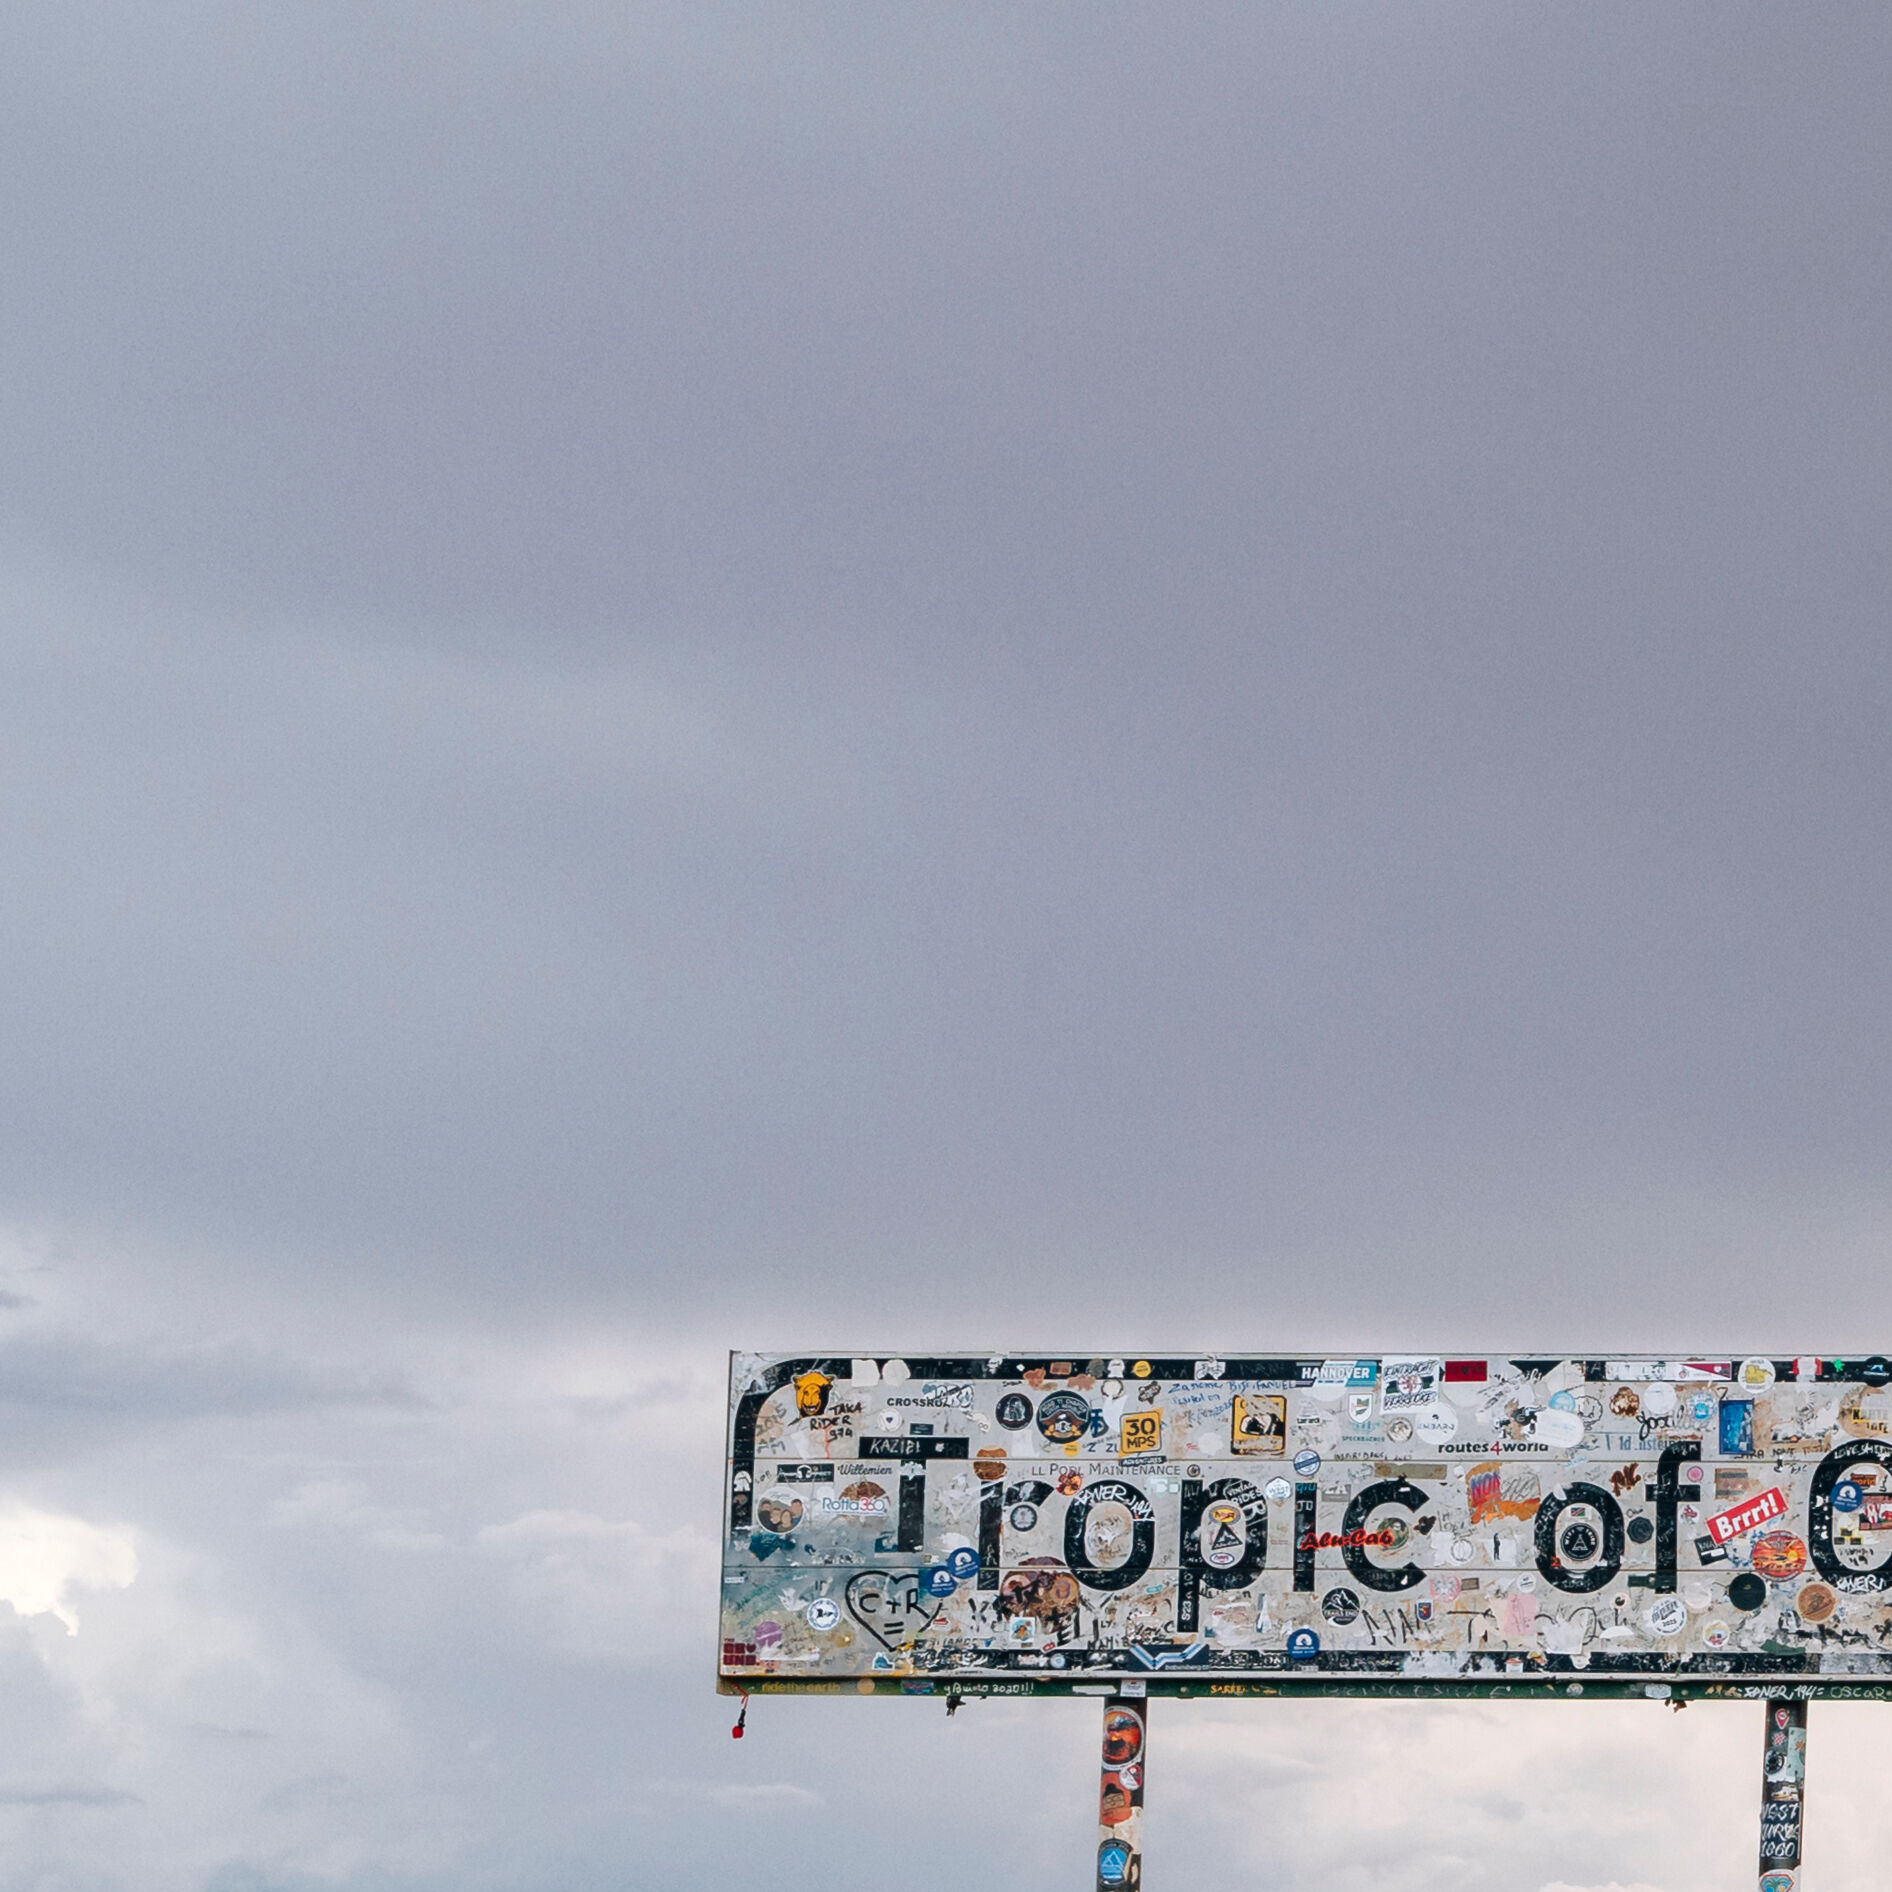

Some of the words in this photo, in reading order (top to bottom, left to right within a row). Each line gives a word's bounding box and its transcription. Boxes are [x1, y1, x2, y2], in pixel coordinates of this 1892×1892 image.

[1302, 1367, 1370, 1379] HANNOVER
[1125, 1418, 1156, 1437] 30
[1126, 1436, 1156, 1449] MPS
[837, 1464, 892, 1475] Willemien
[1088, 1463, 1181, 1476] MAINTENANCE
[822, 1497, 886, 1511] Rotta360
[1715, 1491, 1779, 1540] Brrrt!
[858, 1436, 1431, 1633] Tropic
[1534, 1440, 1701, 1594] of
[1761, 1841, 1796, 1857] 1860
